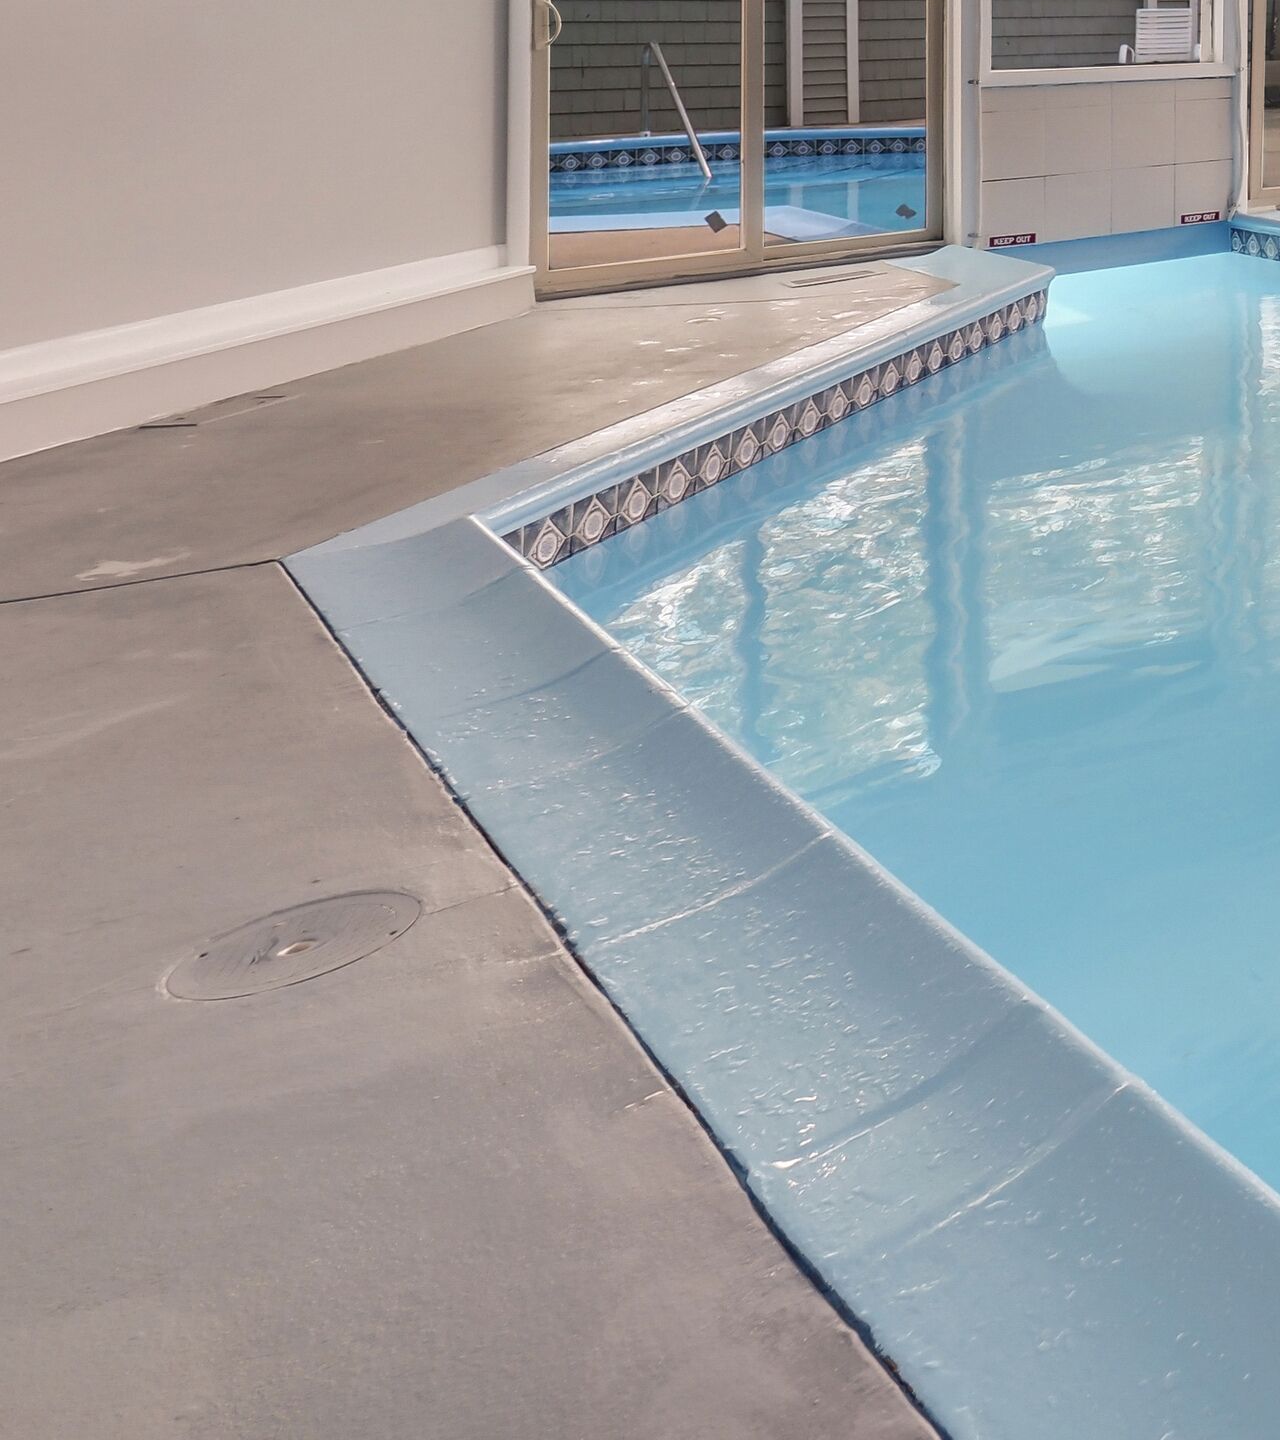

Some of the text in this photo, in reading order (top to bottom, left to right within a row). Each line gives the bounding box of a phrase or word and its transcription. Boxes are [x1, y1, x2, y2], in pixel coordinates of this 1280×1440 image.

[1184, 212, 1217, 224] KEEP OUT
[994, 234, 1032, 247] KEEP OUT
